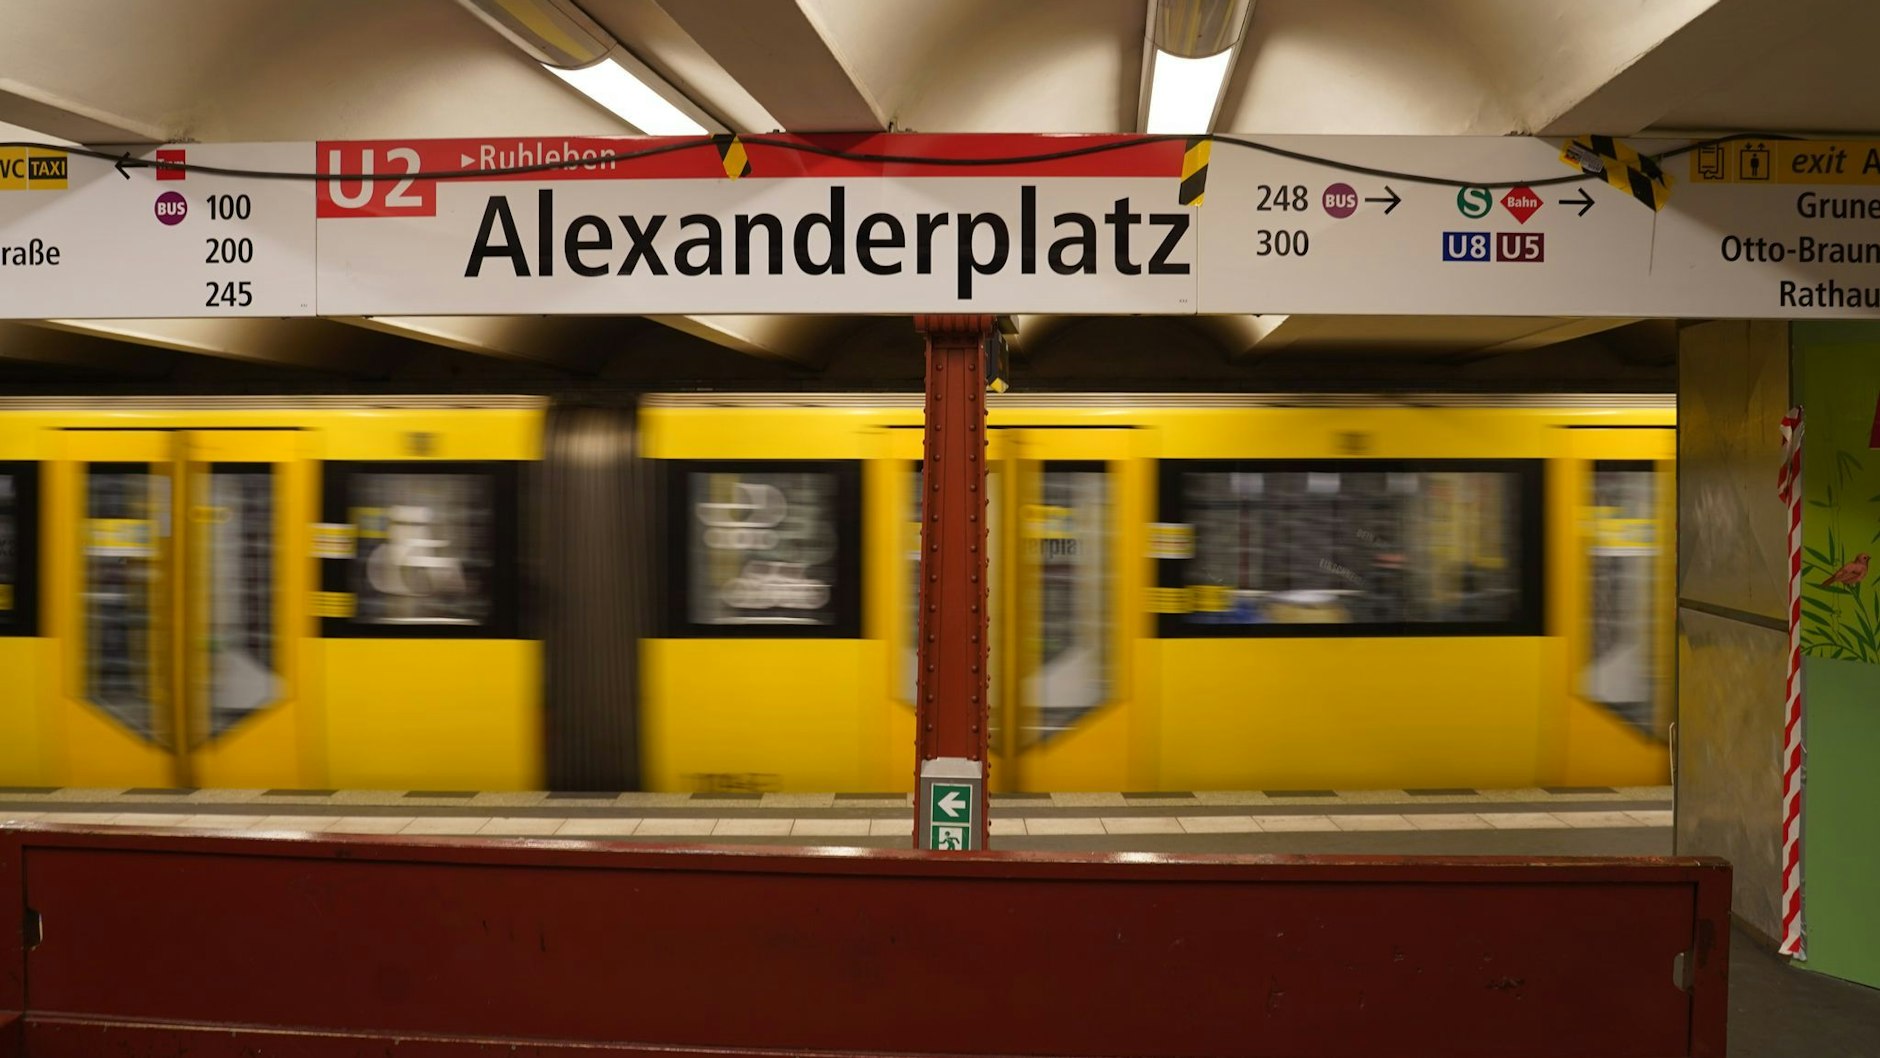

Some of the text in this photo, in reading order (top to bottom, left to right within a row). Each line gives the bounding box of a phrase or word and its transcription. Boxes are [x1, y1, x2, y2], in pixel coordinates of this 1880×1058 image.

[31, 161, 65, 176] TAXI
[480, 141, 616, 171] Ruhleben
[1792, 146, 1880, 175] exit A
[328, 147, 423, 209] U2
[157, 201, 186, 216] BUS
[206, 194, 251, 220] 100
[1256, 185, 1356, 211] 248 BUS
[1461, 187, 1488, 217] S
[1507, 195, 1538, 208] Bahn
[1796, 191, 1880, 219] Grune
[2, 238, 60, 266] raße
[205, 238, 253, 264] 200
[464, 186, 1191, 300] Alexanderplatz
[1256, 230, 1309, 256] 300
[1448, 235, 1487, 259] U8
[1502, 235, 1540, 260] U5
[1721, 234, 1880, 263] Otto-Braun
[205, 281, 253, 307] 245
[1779, 279, 1880, 308] Rathau
